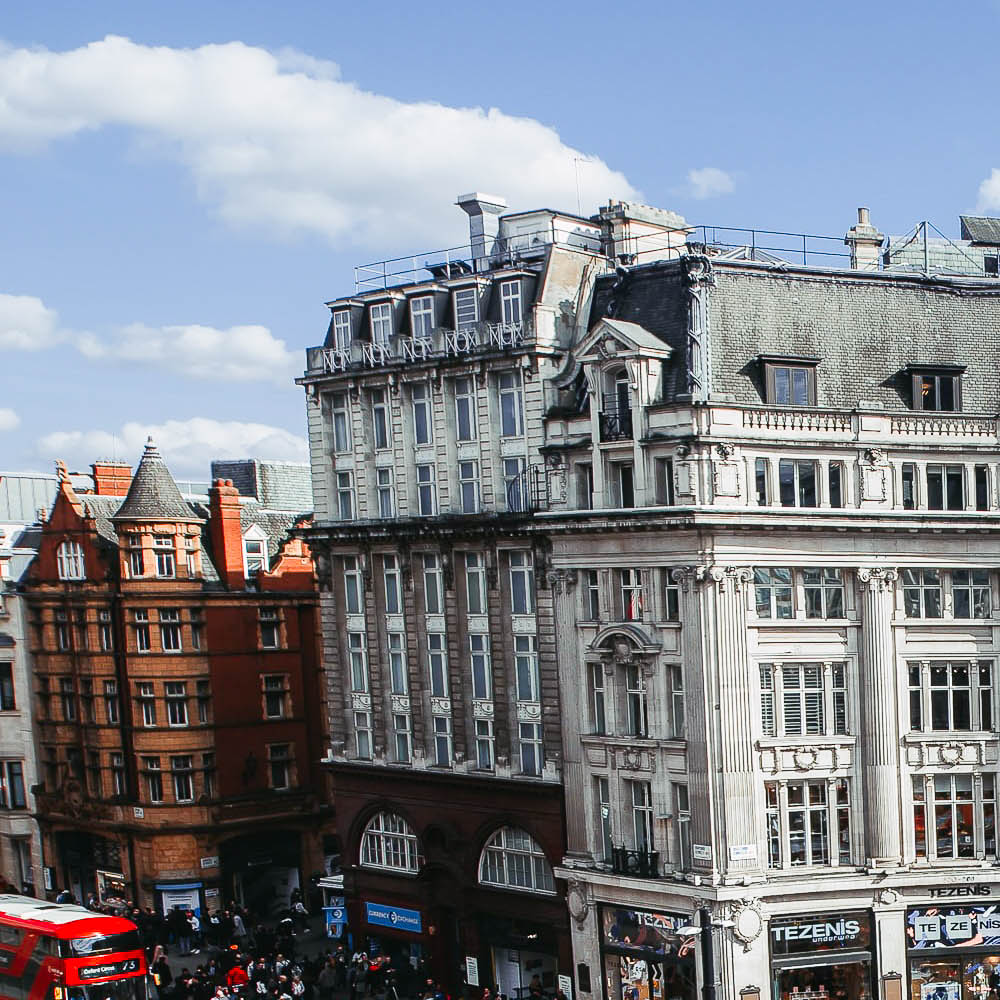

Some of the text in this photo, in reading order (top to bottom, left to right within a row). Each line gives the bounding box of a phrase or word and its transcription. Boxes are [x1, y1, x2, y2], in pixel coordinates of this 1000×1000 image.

[928, 885, 991, 898] TEZENIS
[635, 911, 692, 930] TEZENI
[919, 923, 937, 932] TE
[950, 921, 969, 931] ZE
[771, 919, 860, 941] TEZENIS
